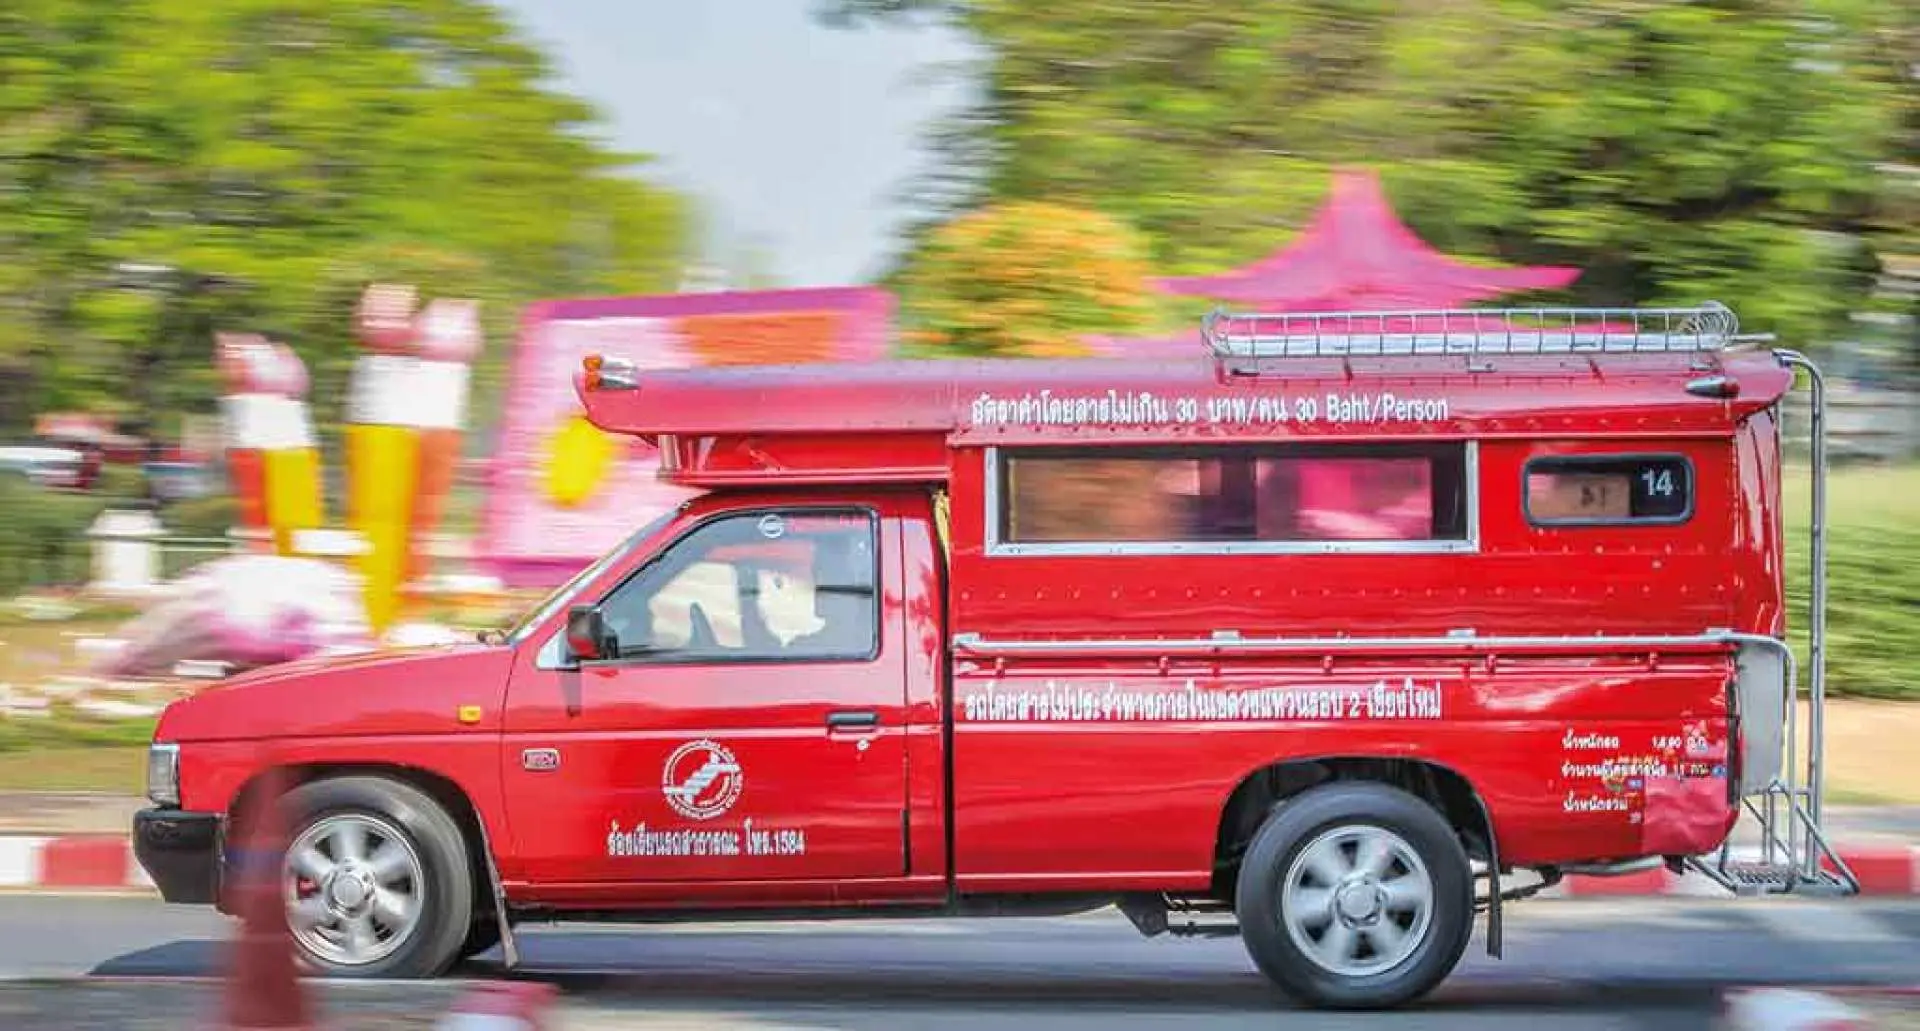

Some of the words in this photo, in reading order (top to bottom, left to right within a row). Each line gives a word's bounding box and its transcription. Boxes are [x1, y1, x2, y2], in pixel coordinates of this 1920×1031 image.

[1176, 398, 1197, 422] 30
[1208, 398, 1288, 426] บาท/คน
[1296, 398, 1317, 422] 30
[1327, 393, 1449, 426] Baht/Person
[1641, 468, 1674, 496] 14
[1367, 677, 1441, 719] เชียงใหม่
